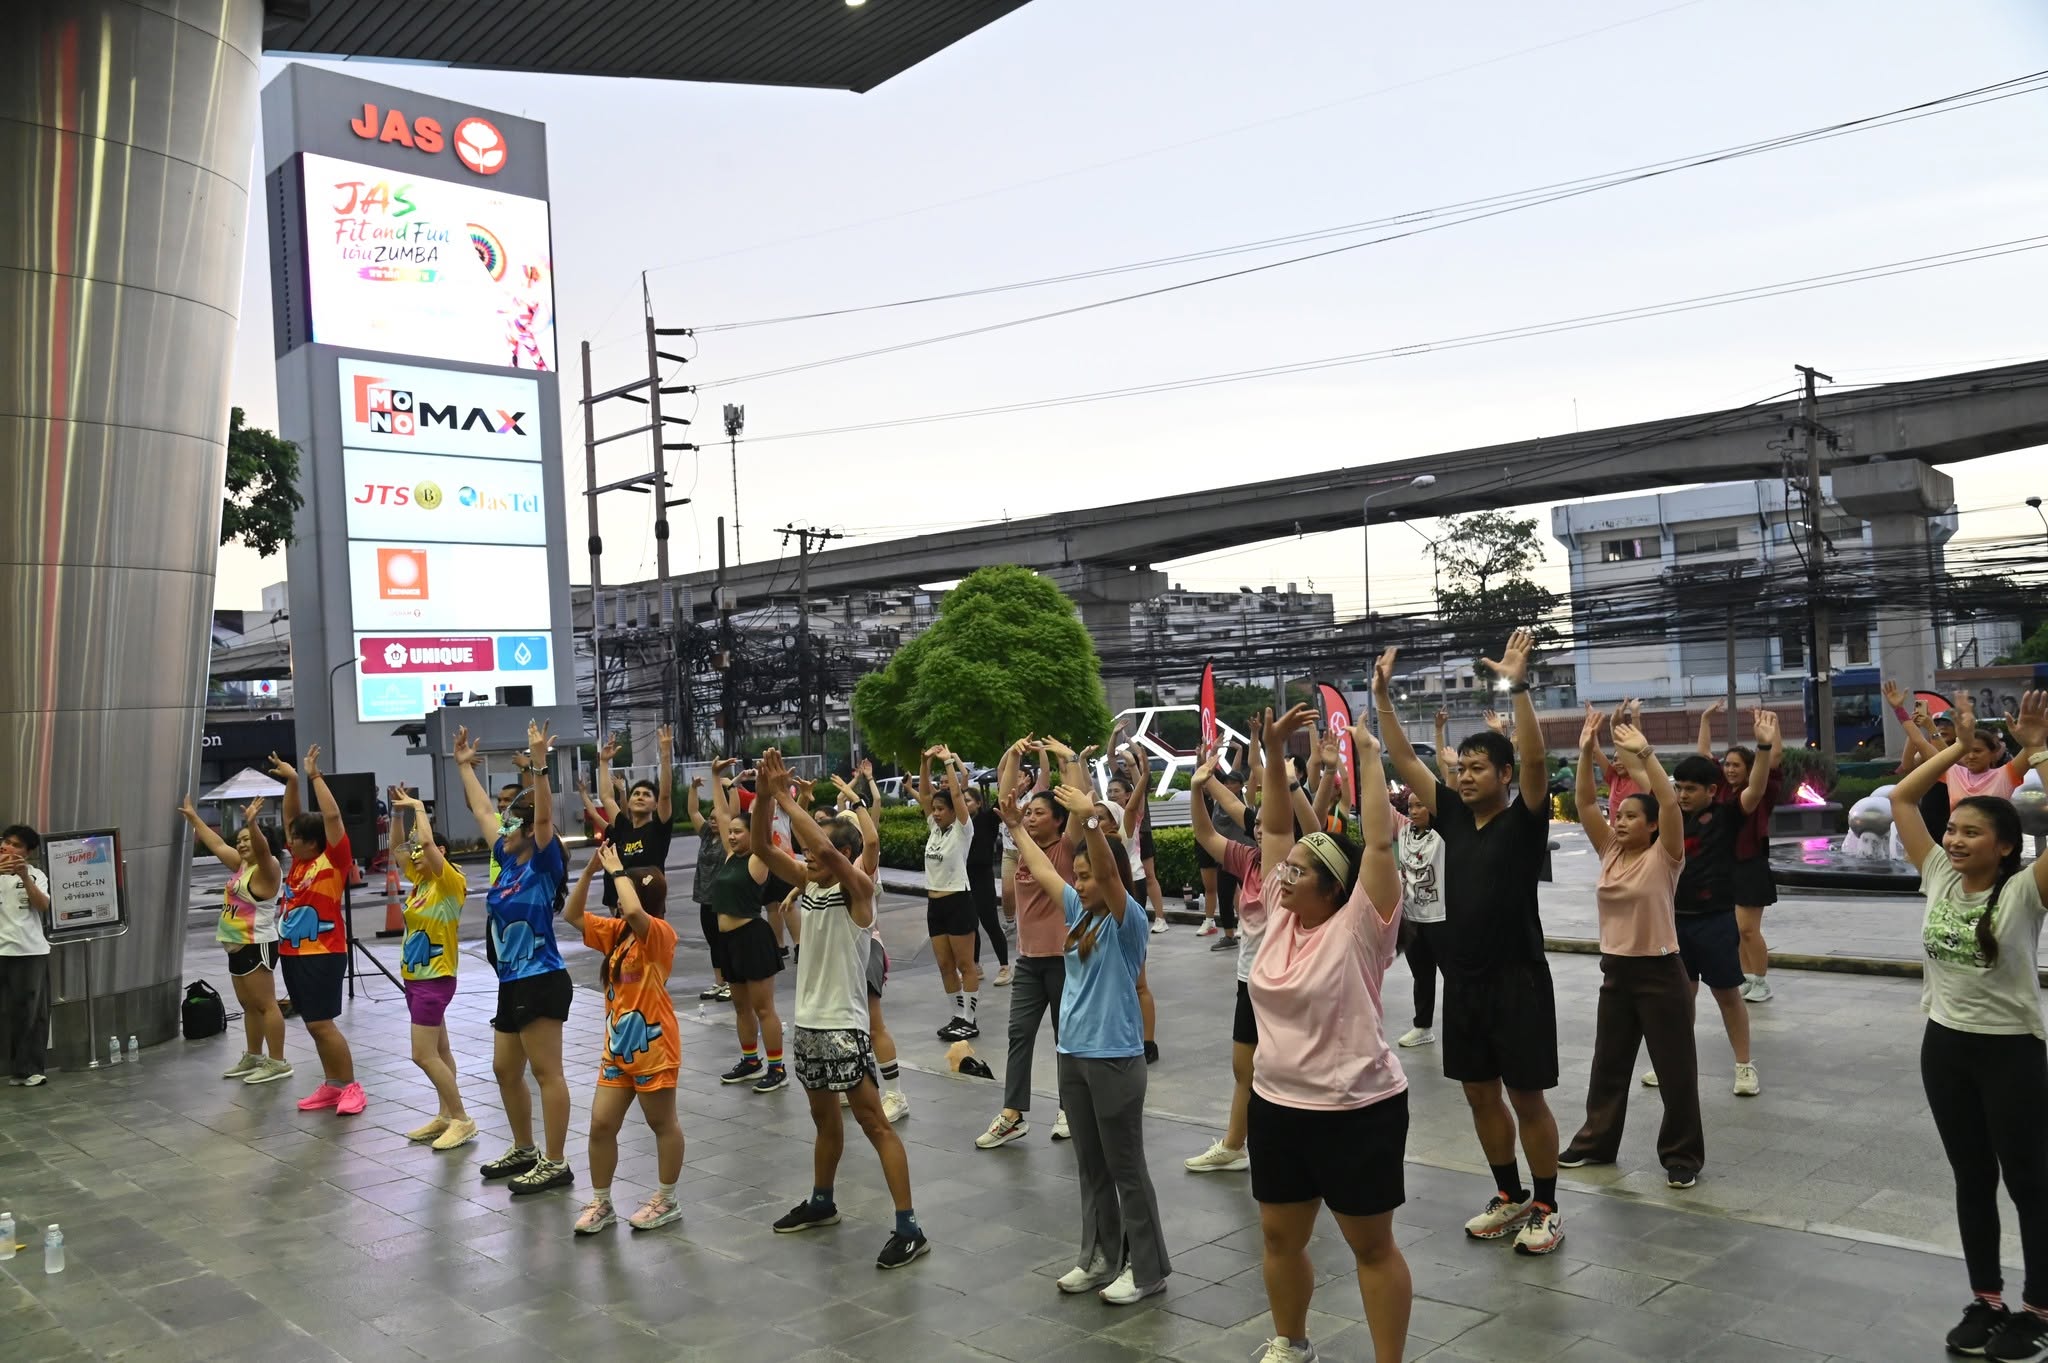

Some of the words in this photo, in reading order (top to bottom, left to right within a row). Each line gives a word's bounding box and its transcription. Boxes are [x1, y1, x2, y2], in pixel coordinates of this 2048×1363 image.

[351, 103, 445, 153] JAS
[333, 181, 416, 217] JAS
[334, 218, 372, 244] Fit
[373, 221, 408, 241] and
[413, 221, 450, 243] Fun
[374, 246, 438, 263] ZUMBA
[354, 485, 410, 505] JTS
[409, 647, 474, 665] UNIQUE
[62, 879, 105, 890] CHECK-IN
